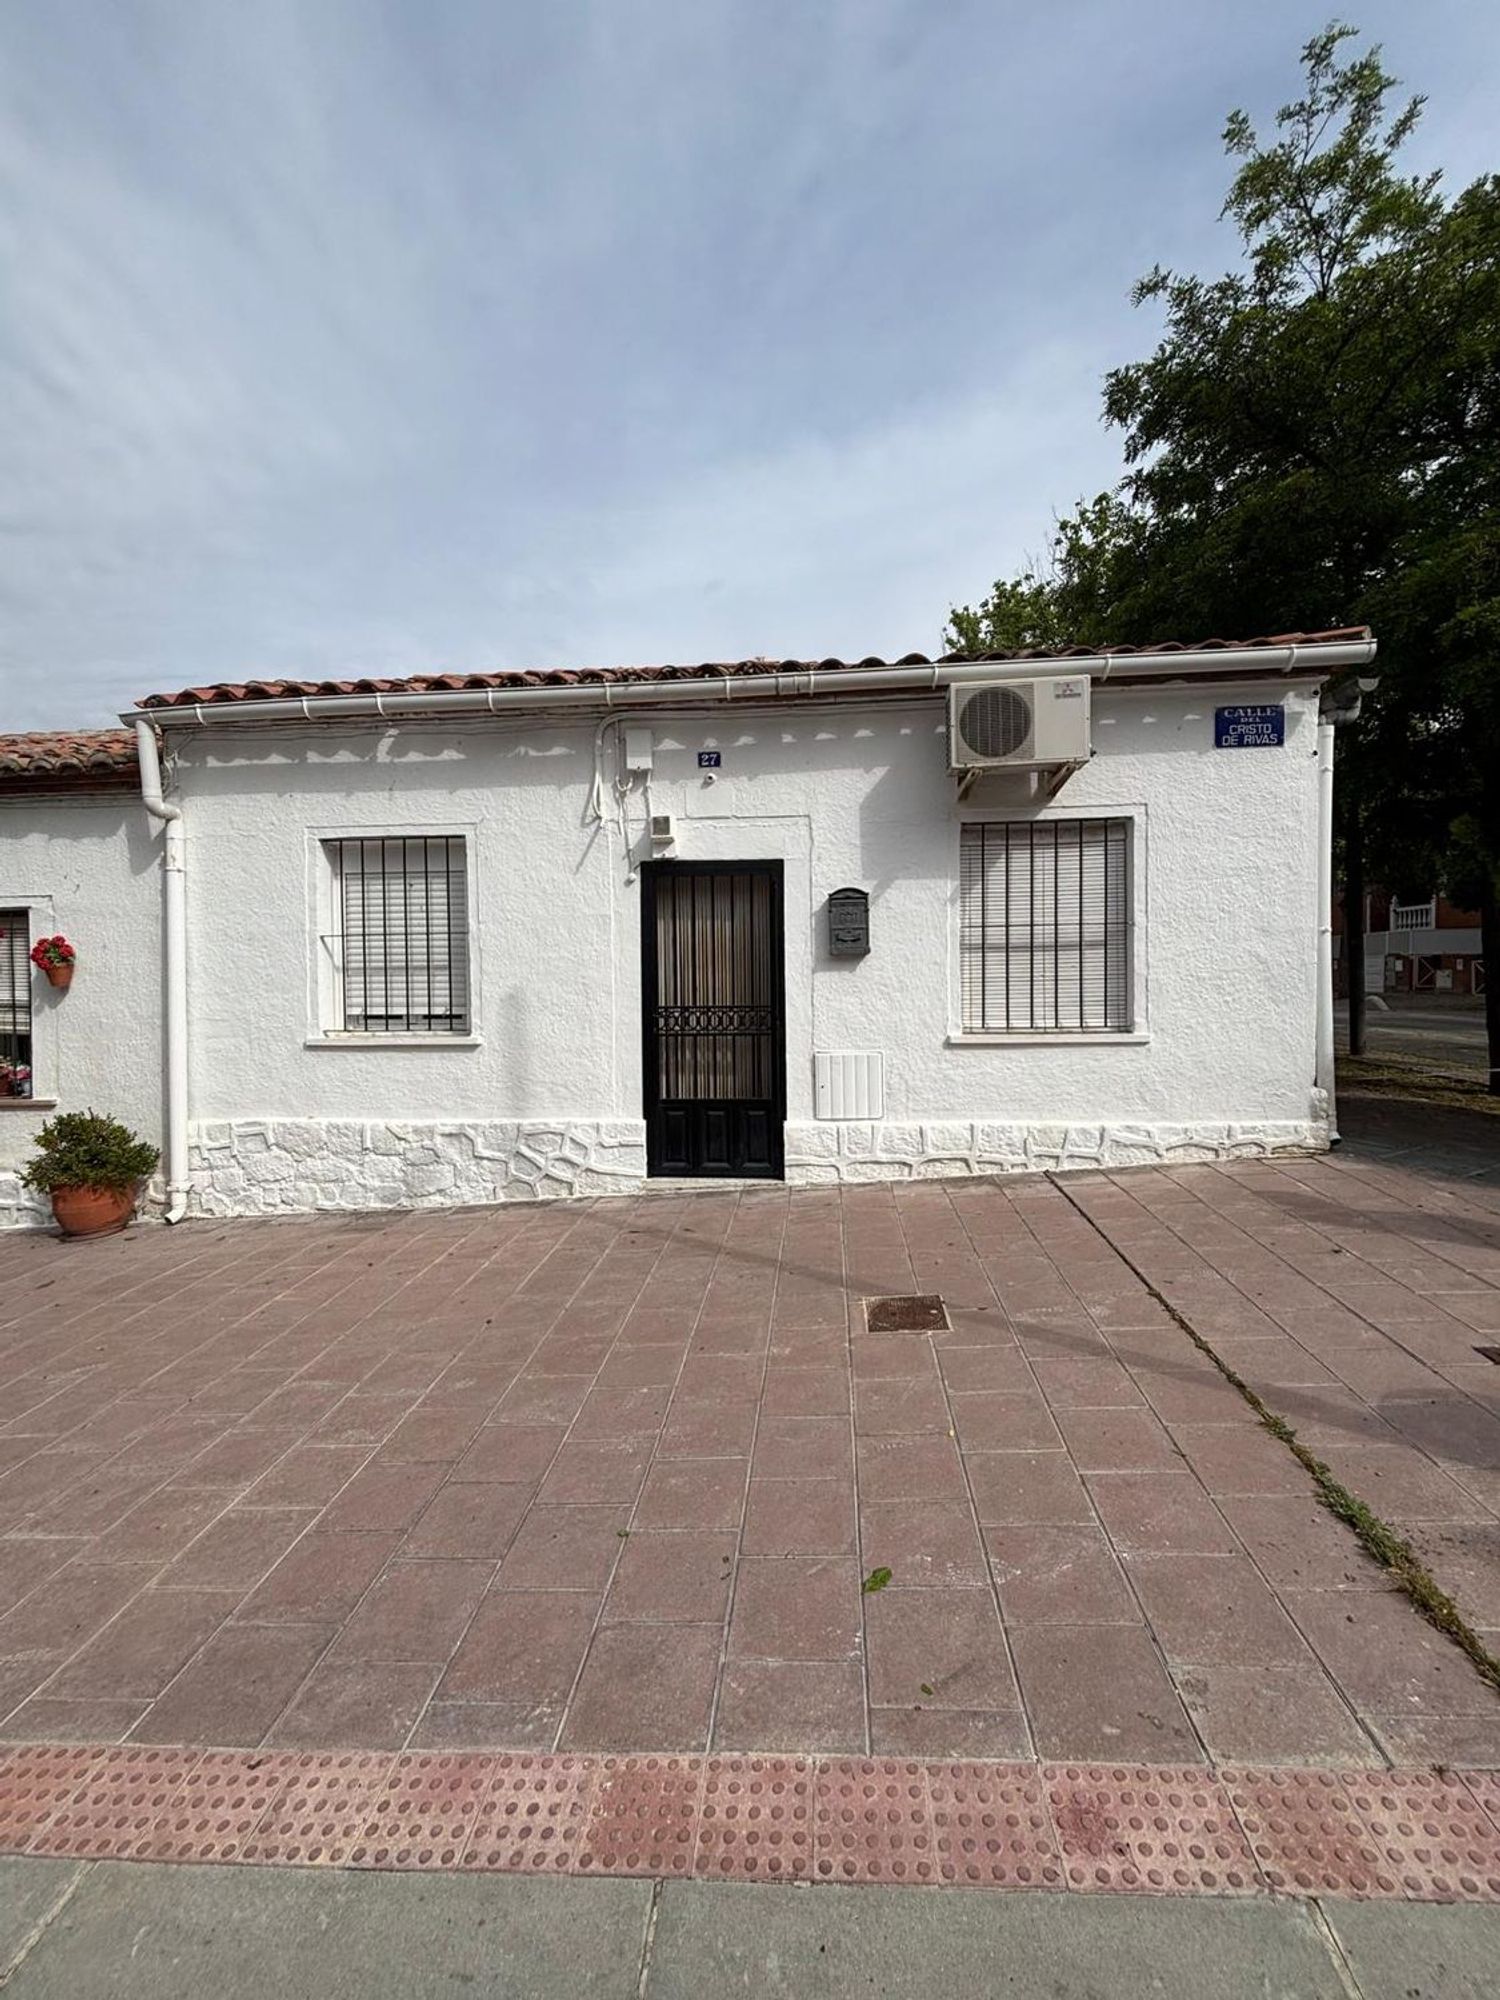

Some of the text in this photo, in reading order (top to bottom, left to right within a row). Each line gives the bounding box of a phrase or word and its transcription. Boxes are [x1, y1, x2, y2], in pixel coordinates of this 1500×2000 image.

[1223, 707, 1277, 718] CALLE
[1229, 723, 1272, 735] CRISTO
[1222, 733, 1278, 746] DE RIVAS
[701, 754, 717, 766] 27
